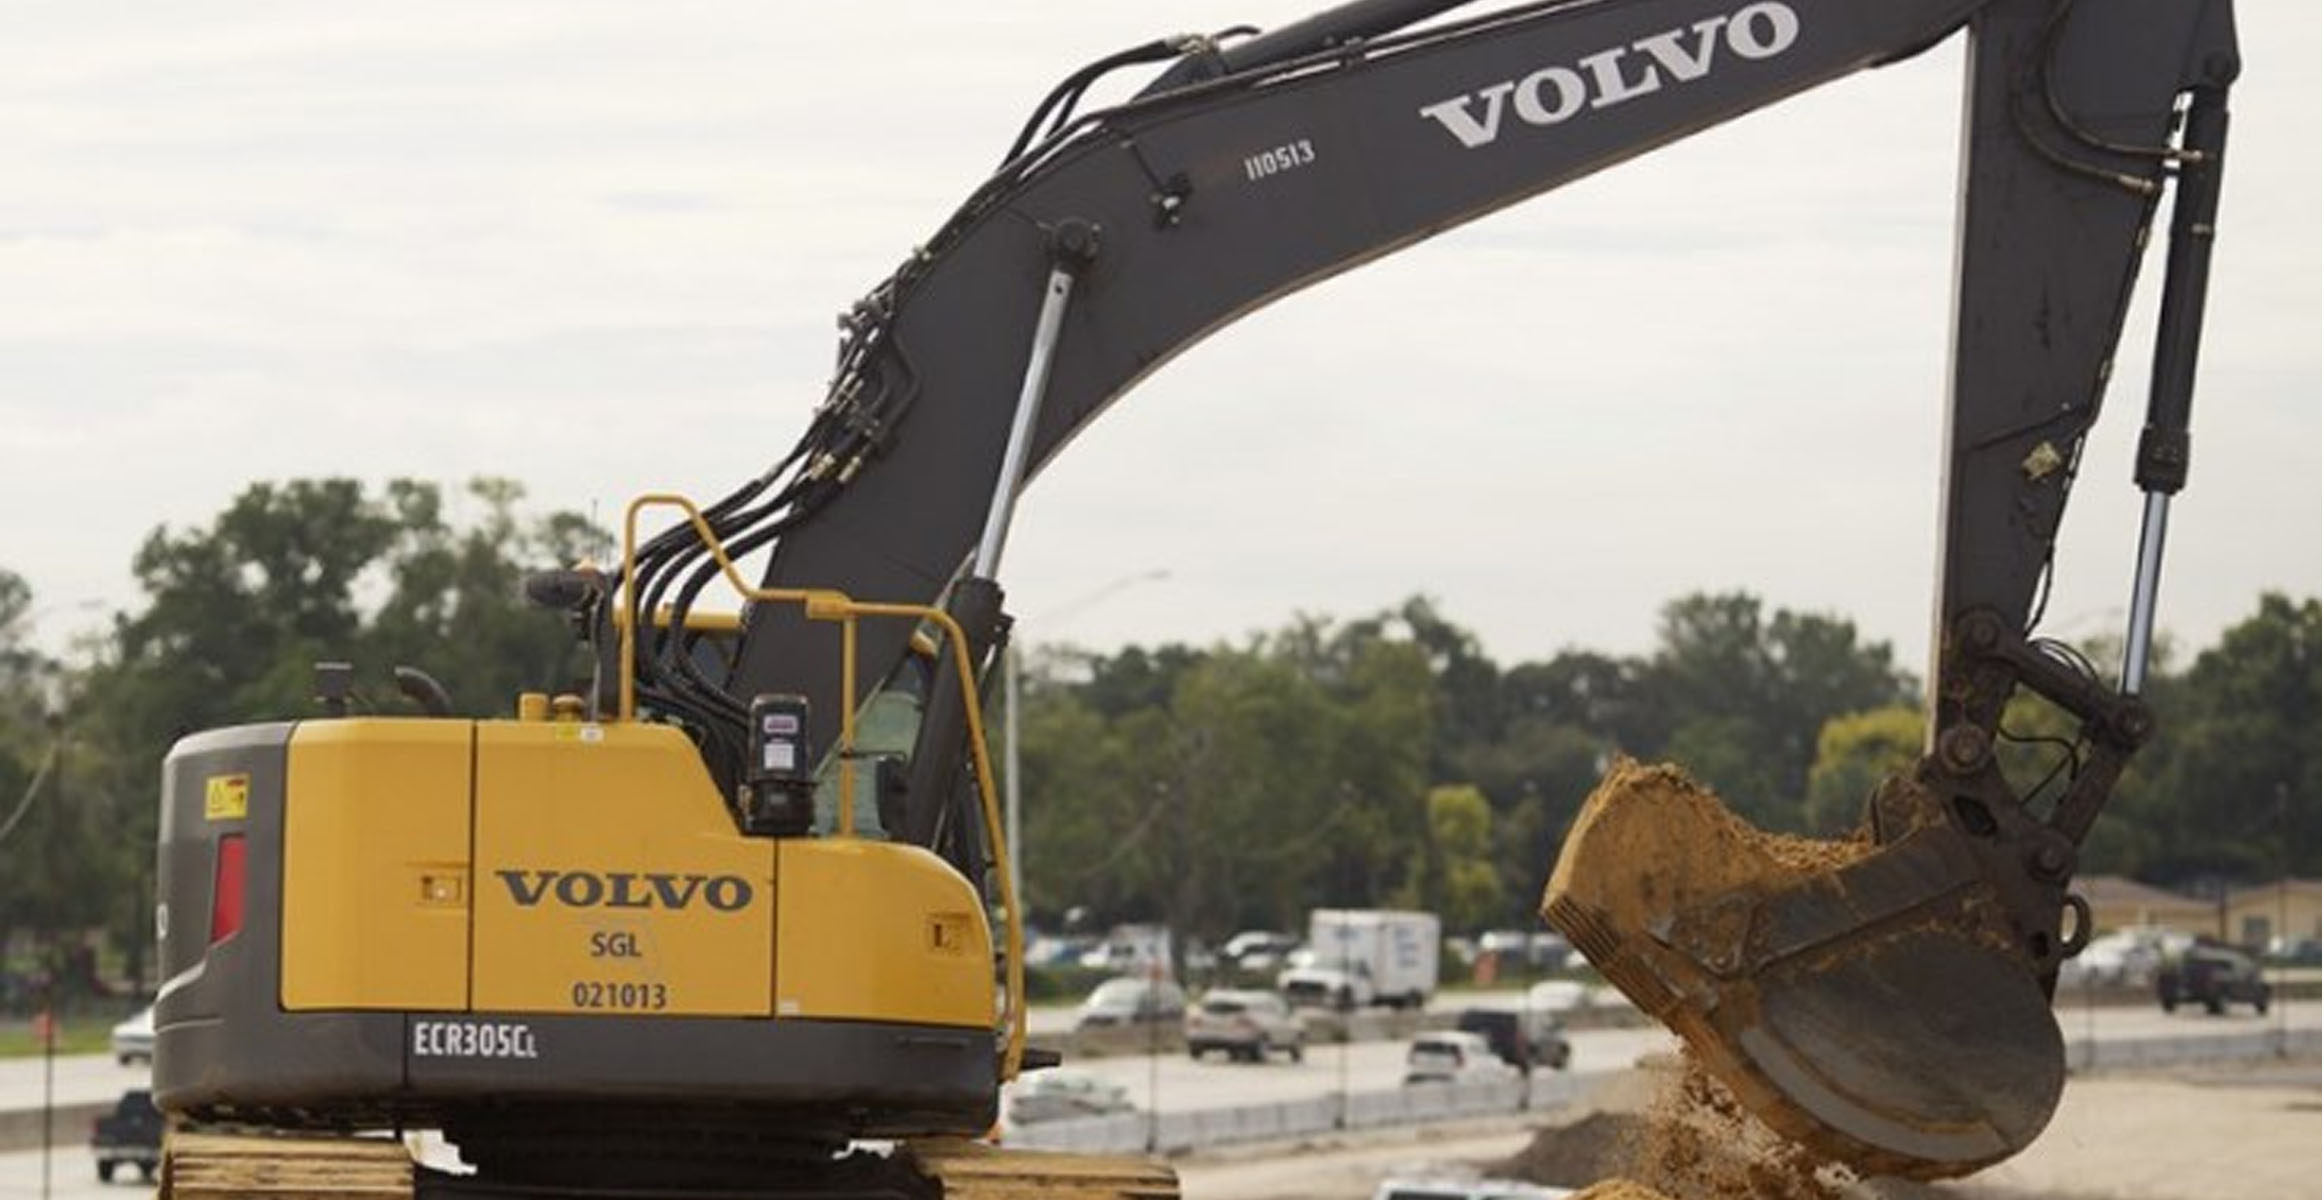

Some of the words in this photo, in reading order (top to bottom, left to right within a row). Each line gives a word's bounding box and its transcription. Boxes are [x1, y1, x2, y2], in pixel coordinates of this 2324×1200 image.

[1420, 1, 1799, 149] VOLVO
[1244, 139, 1315, 181] 110513
[494, 870, 753, 911] VOLVO
[590, 931, 642, 957] SGL
[573, 982, 668, 1009] 021013
